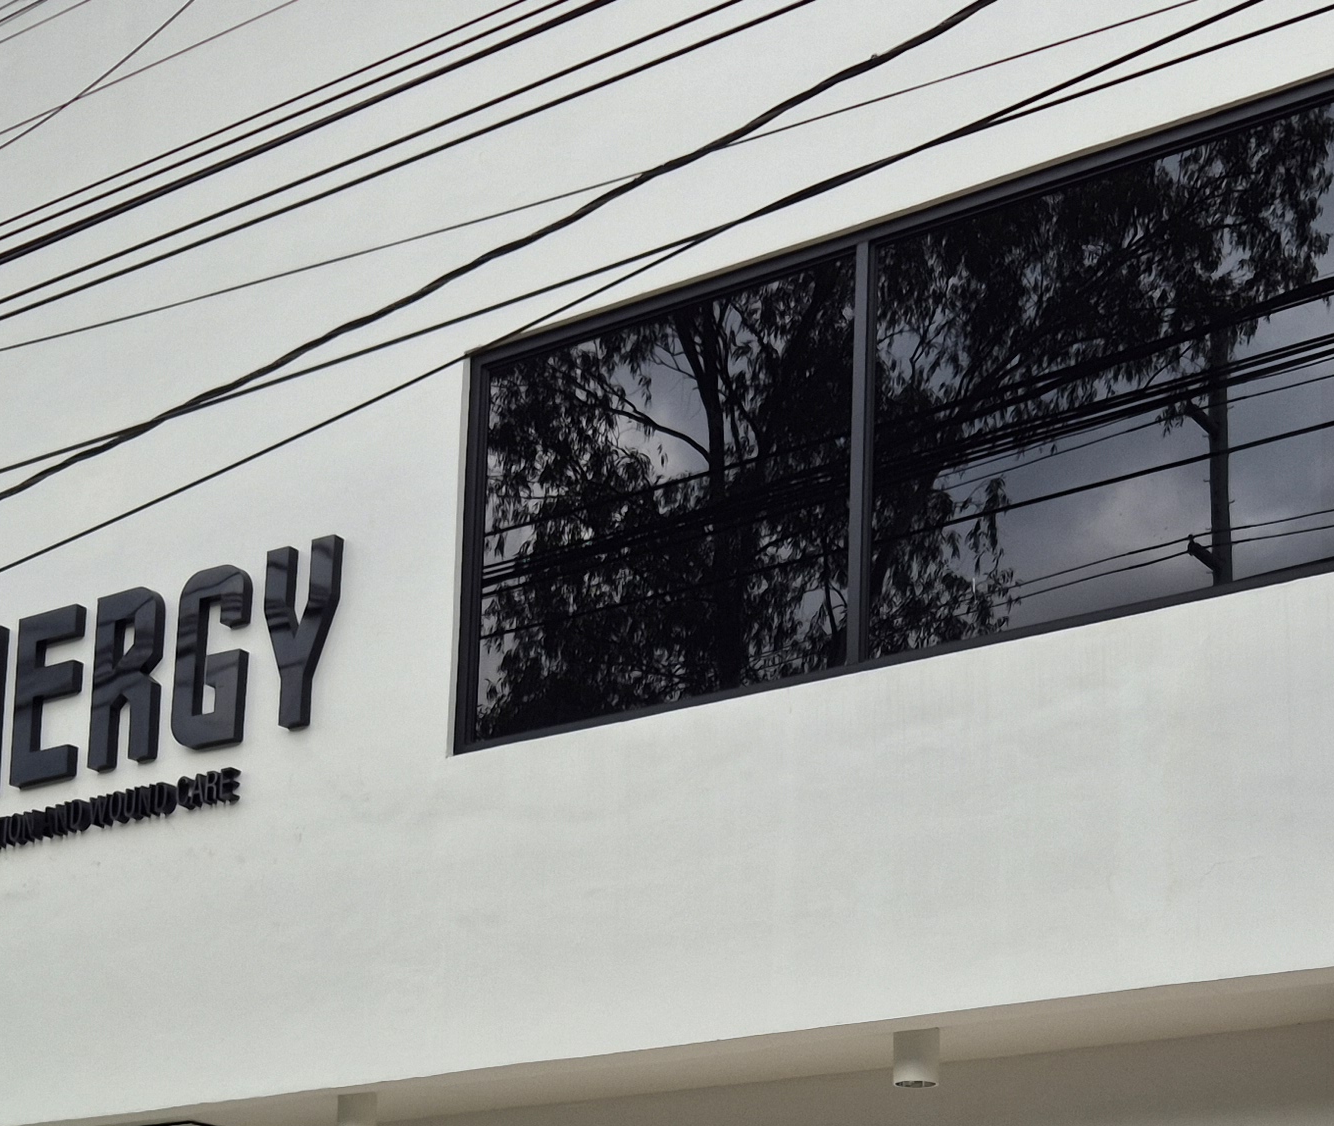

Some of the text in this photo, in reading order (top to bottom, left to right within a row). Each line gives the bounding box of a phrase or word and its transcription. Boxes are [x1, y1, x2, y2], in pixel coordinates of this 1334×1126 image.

[41, 798, 90, 839] AND
[89, 782, 177, 828] WOUND
[177, 767, 241, 810] CARE
